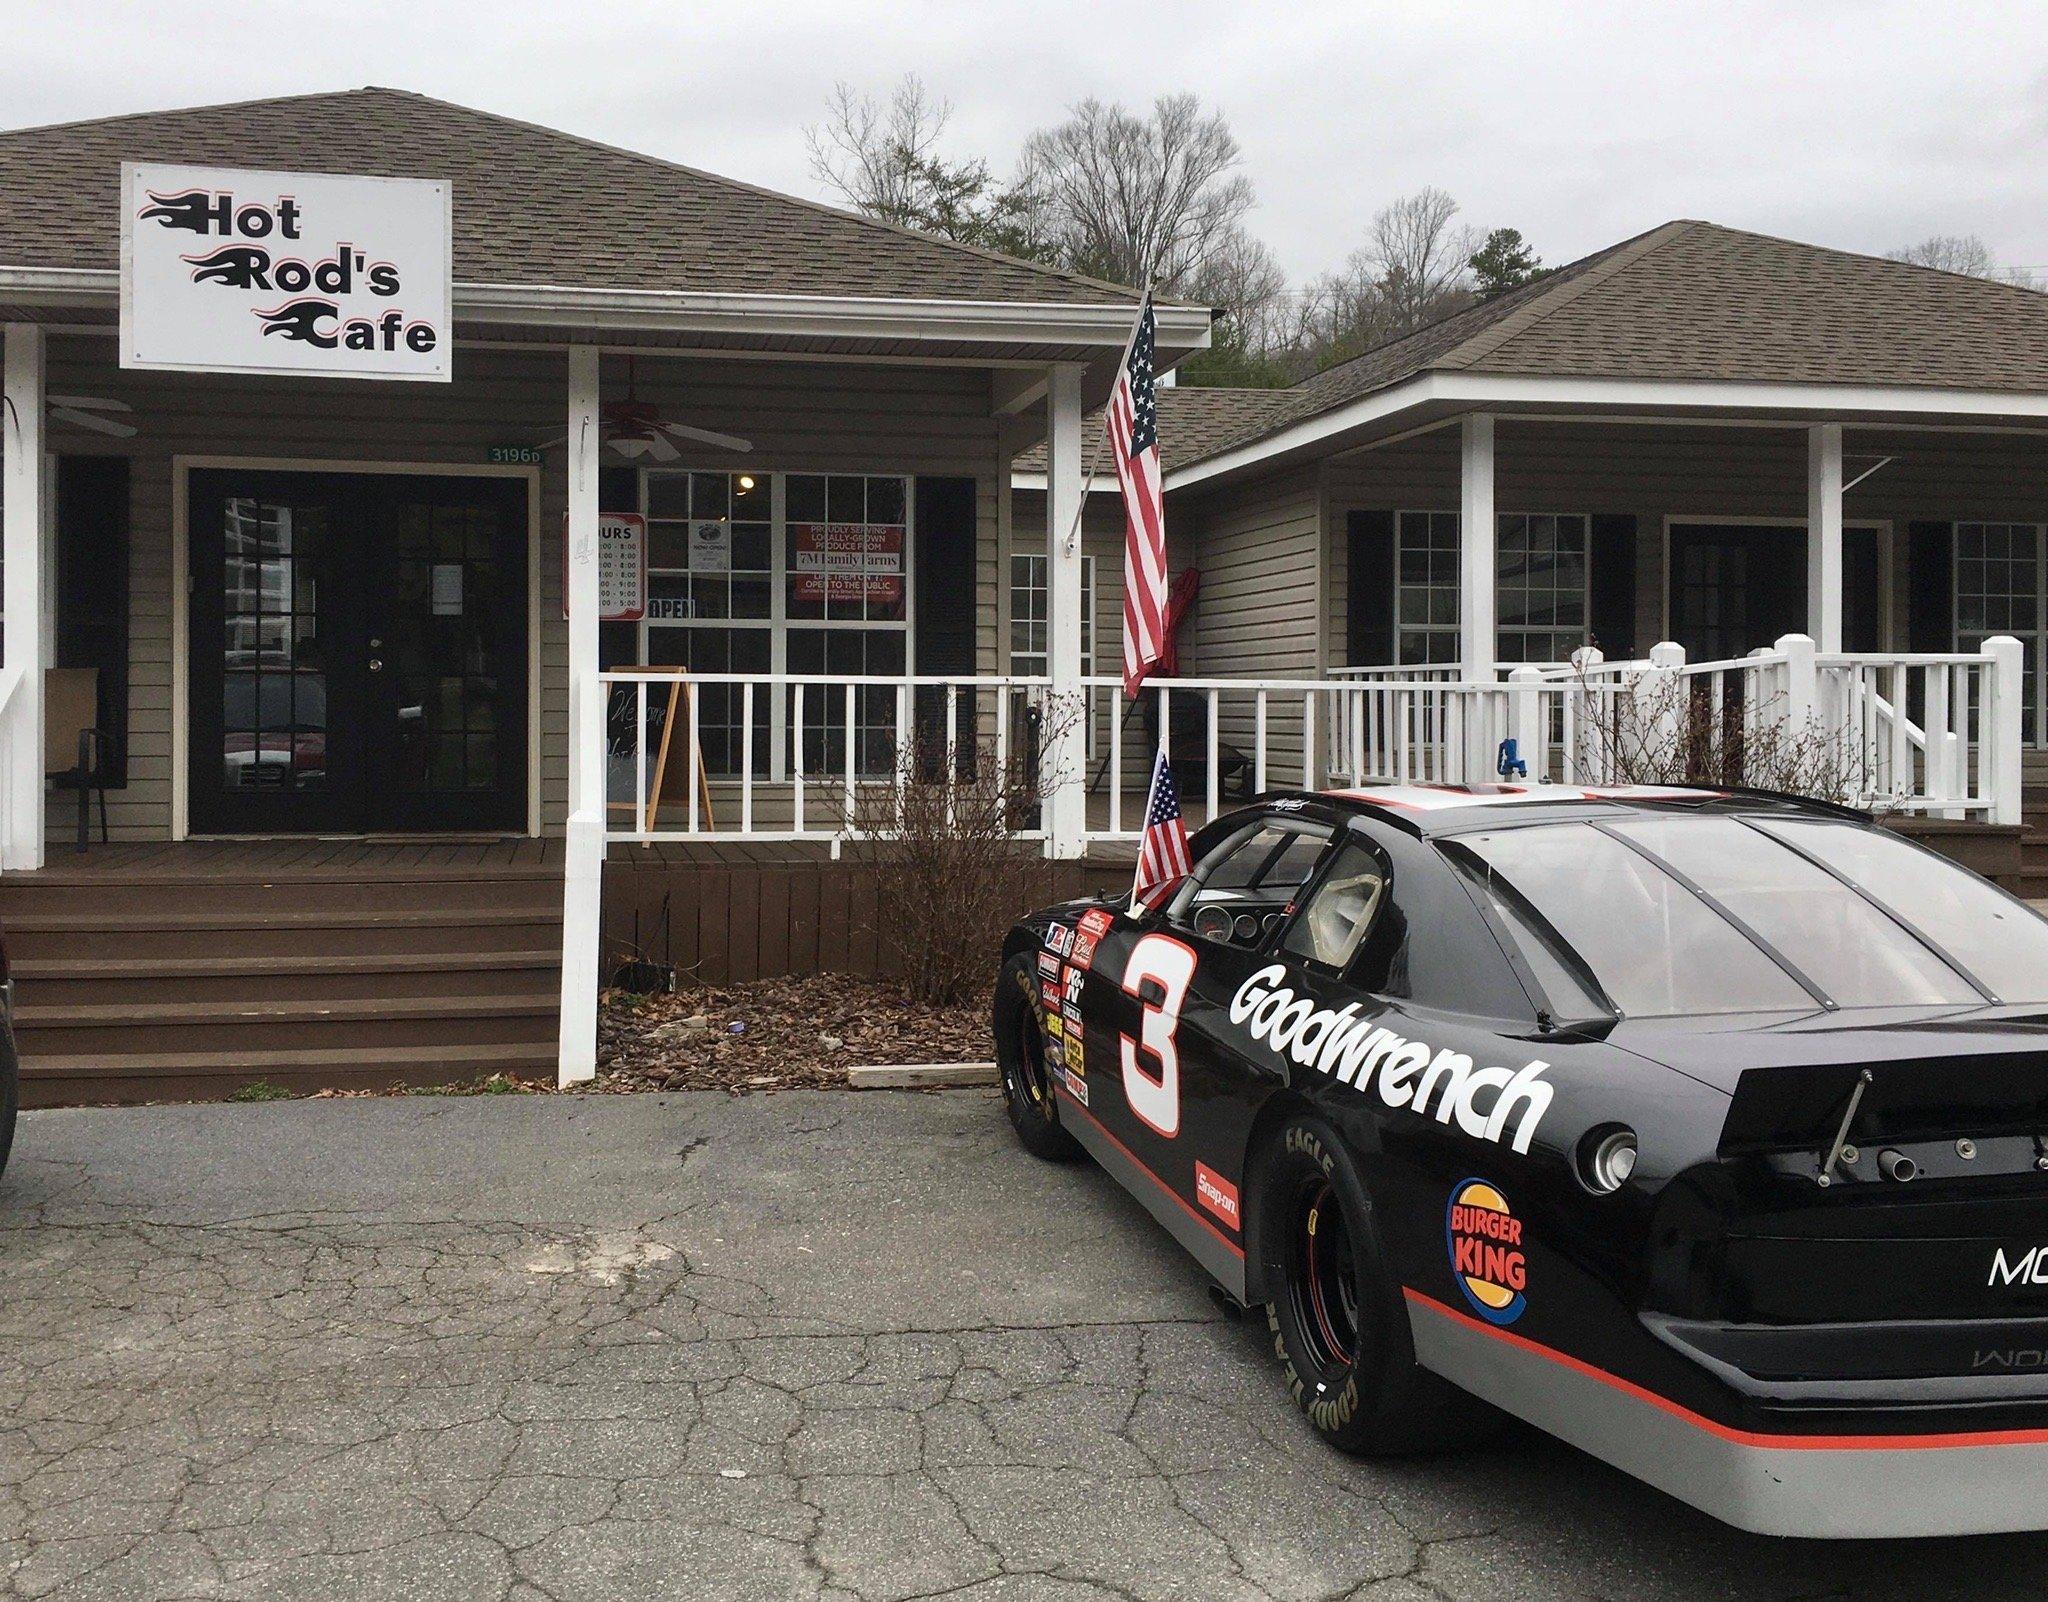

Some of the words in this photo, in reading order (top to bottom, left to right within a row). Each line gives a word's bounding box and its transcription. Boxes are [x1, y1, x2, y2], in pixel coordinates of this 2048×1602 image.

[140, 188, 301, 240] Hot
[180, 243, 401, 296] Rod's
[252, 297, 437, 353] Cafe
[599, 527, 632, 539] URS
[800, 553, 818, 564] 7M
[648, 600, 694, 618] OPEN
[805, 580, 828, 588] OPE
[830, 581, 842, 589] TO
[844, 581, 860, 589] THE
[862, 582, 891, 590] UBLIC
[1120, 933, 1197, 1139] 3
[1229, 964, 1554, 1155] Goodwrench
[1286, 1127, 1334, 1178] EAGLE
[1198, 1173, 1236, 1214] Snap-on
[1451, 1205, 1522, 1246] BURGER
[1455, 1237, 1526, 1291] KING
